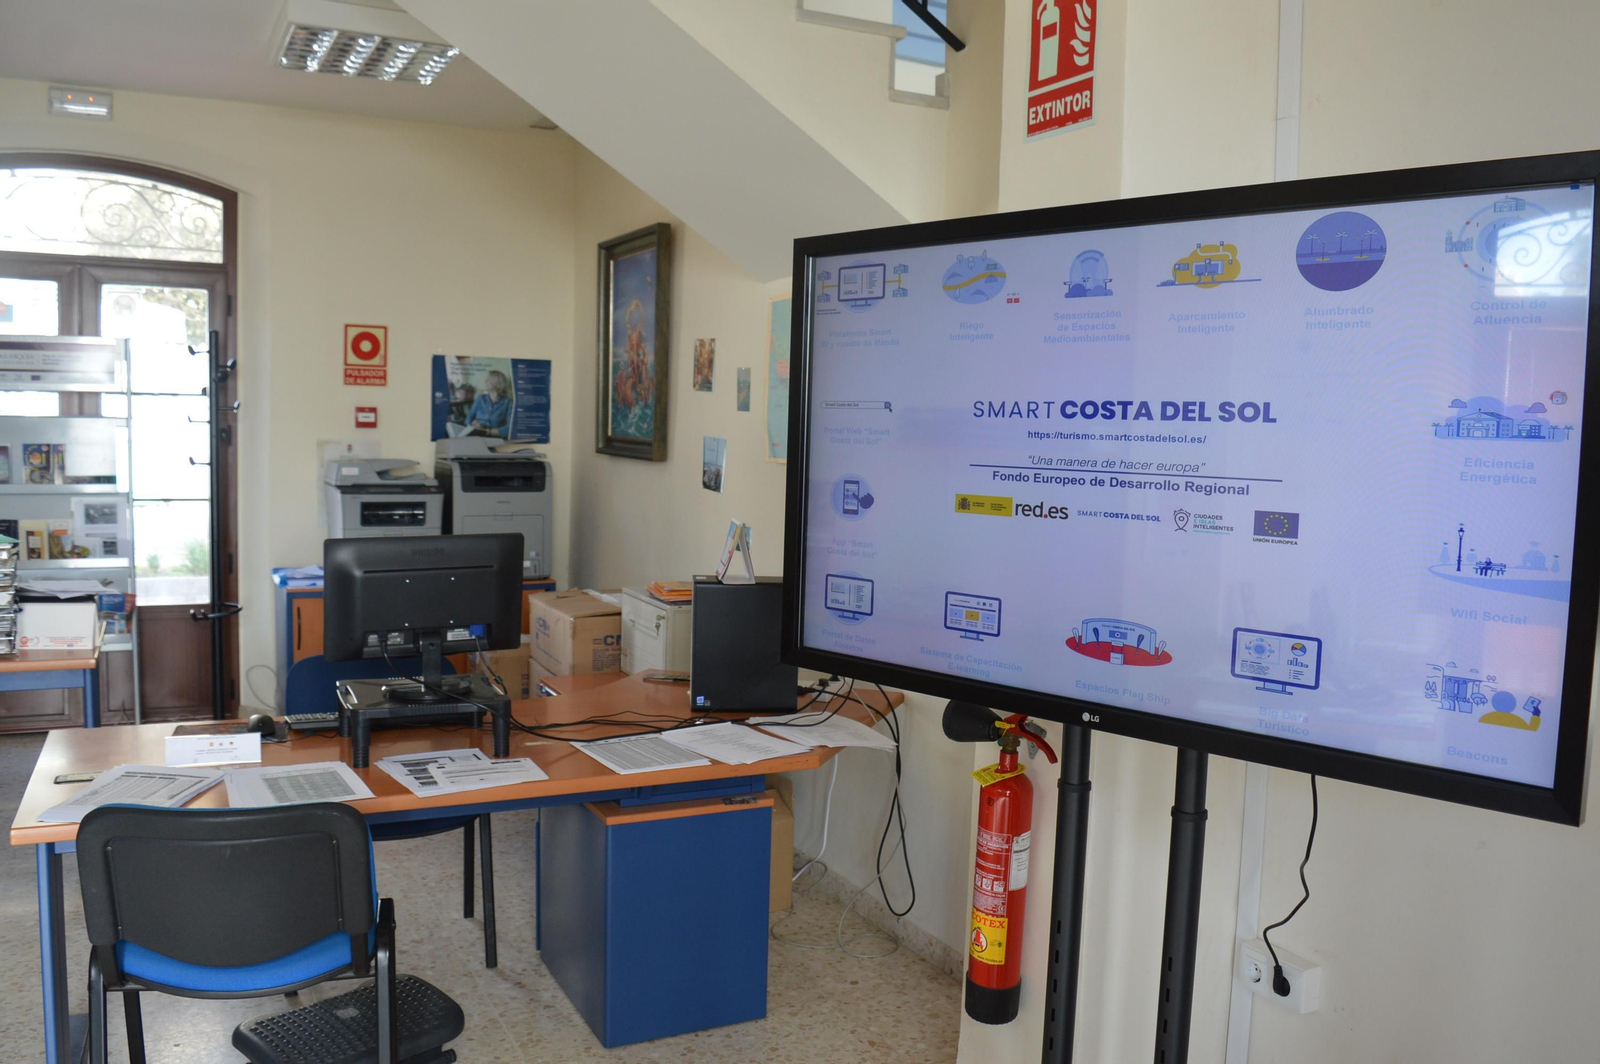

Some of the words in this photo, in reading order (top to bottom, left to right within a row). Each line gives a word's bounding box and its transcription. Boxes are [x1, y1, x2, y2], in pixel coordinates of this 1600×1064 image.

[1029, 90, 1091, 126] EXTINTOR
[1303, 305, 1374, 317] Alumbrado
[1470, 301, 1524, 311] Control
[1529, 301, 1546, 309] de
[1053, 310, 1122, 320] Sensorización
[1168, 311, 1246, 323] Aparcamiento
[1473, 314, 1542, 325] Afluencia
[959, 322, 984, 331] Riego
[1057, 323, 1070, 331] de
[1072, 322, 1116, 332] Espacios
[1178, 323, 1235, 334] Inteligente
[1305, 319, 1372, 331] Inteligente
[950, 332, 994, 342] Inteligente
[1043, 333, 1131, 344] Medioambientales
[346, 369, 384, 377] PULSADOR
[973, 401, 1055, 419] SMART
[1060, 400, 1154, 421] COSTA
[1160, 401, 1212, 422] DEL
[1218, 401, 1277, 423] SOL
[1028, 431, 1207, 444] https://turismo.smartcostadelsol.es/
[1056, 459, 1097, 468] manera
[1101, 459, 1116, 469] de
[1119, 459, 1153, 471] hacer
[1464, 457, 1535, 470] Eficiencia
[993, 471, 1030, 483] Fondo
[1033, 473, 1086, 487] Europeo
[1090, 476, 1106, 487] de
[1109, 477, 1180, 491] Desarrollo
[1185, 481, 1250, 496] Regional
[1460, 471, 1537, 485] Energética
[1015, 501, 1069, 520] red.es
[1077, 510, 1102, 518] SMART
[1103, 511, 1129, 520] COSTA
[1131, 513, 1145, 521] DEL
[1193, 523, 1234, 531] INTELIGENTES
[1451, 607, 1478, 620] Wifi
[1483, 611, 1527, 625] Social
[919, 646, 951, 660] Sistema
[953, 652, 964, 661] de
[966, 654, 1023, 672] Capacitación
[1075, 680, 1120, 695] Espacios
[1123, 688, 1144, 701] Flag
[1147, 692, 1171, 706] Ship
[1090, 714, 1100, 722] LG
[1259, 706, 1279, 720] Big
[1447, 746, 1509, 765] Beacons
